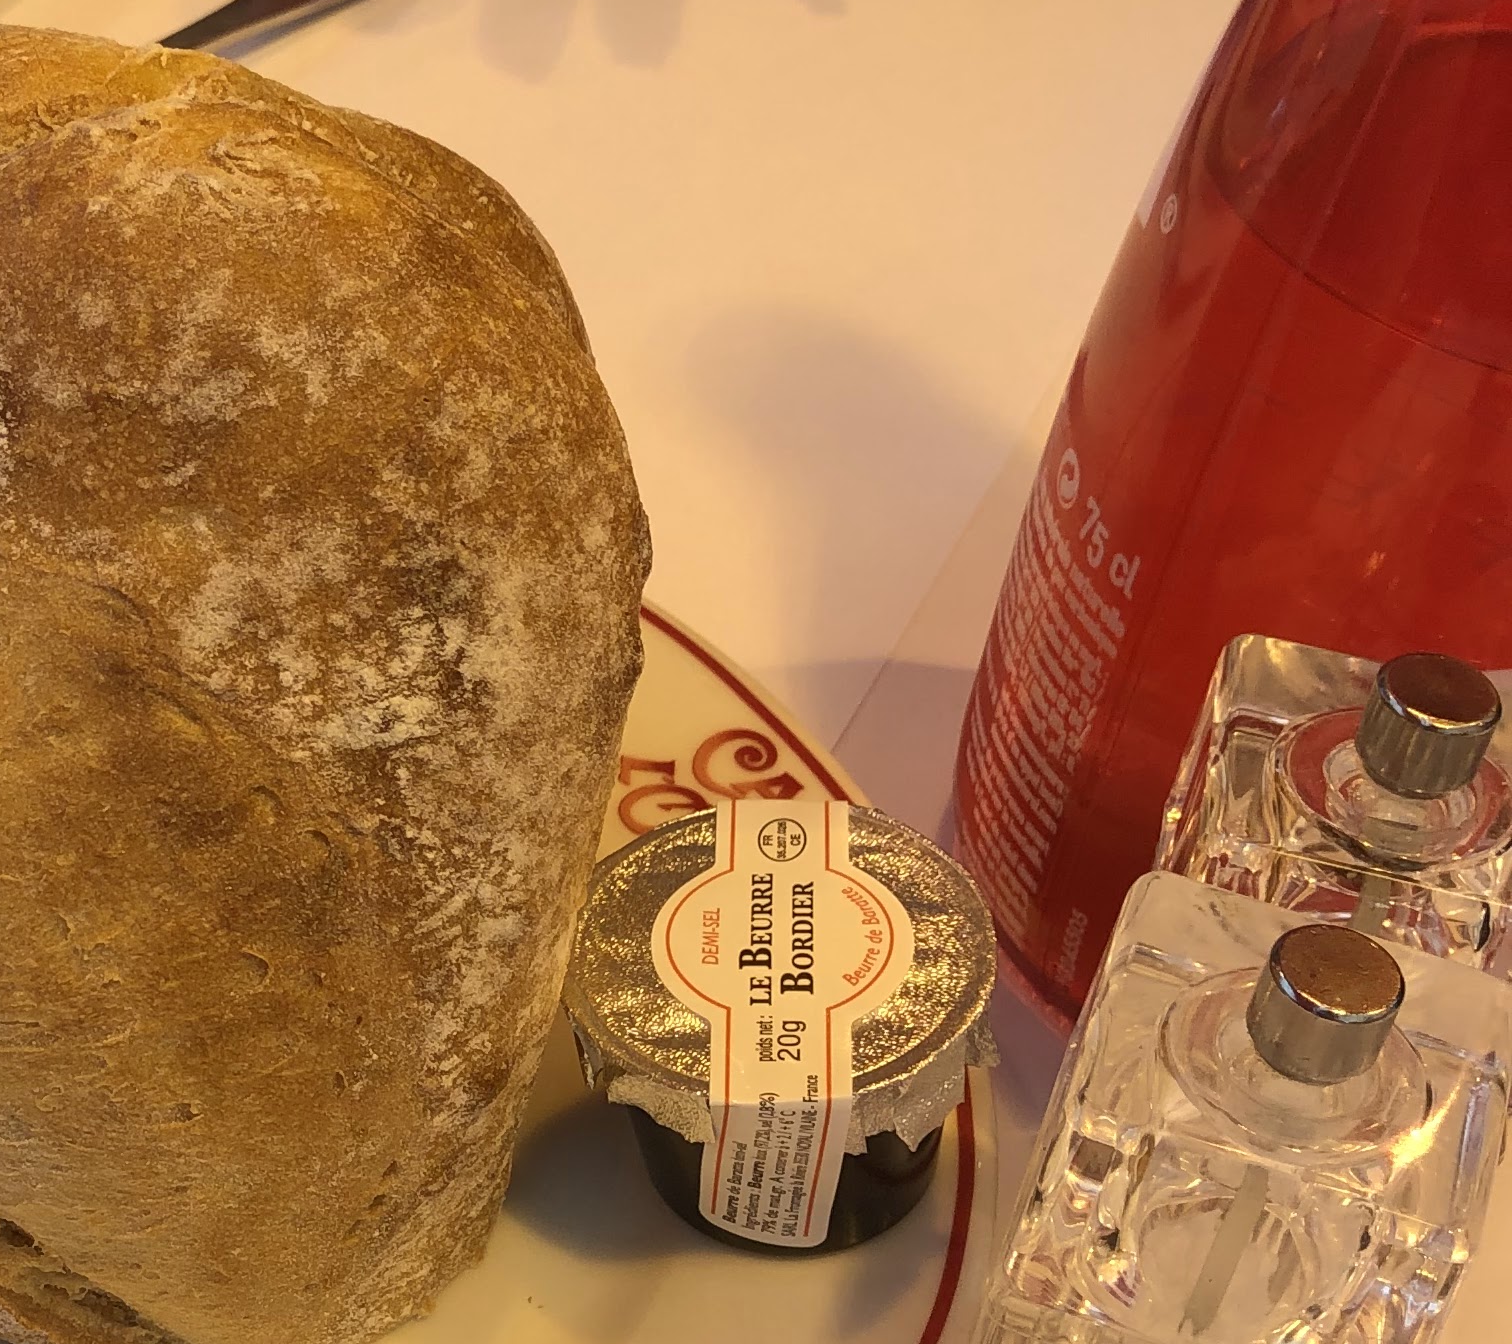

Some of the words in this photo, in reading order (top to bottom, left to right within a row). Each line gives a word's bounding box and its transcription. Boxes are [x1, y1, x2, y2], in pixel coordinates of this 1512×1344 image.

[1078, 495, 1110, 569] 75
[1108, 552, 1142, 601] cl
[762, 834, 774, 846] FR
[790, 833, 801, 846] CE
[738, 873, 774, 970] BEURRE
[841, 886, 881, 926] Baratte
[701, 907, 721, 966] DEMI-SEL
[780, 881, 815, 995] BORDIER
[864, 929, 883, 944] de
[841, 947, 882, 987] Beurre
[749, 975, 773, 1006] LE
[776, 1020, 807, 1062] 20g
[802, 1074, 819, 1103] France
